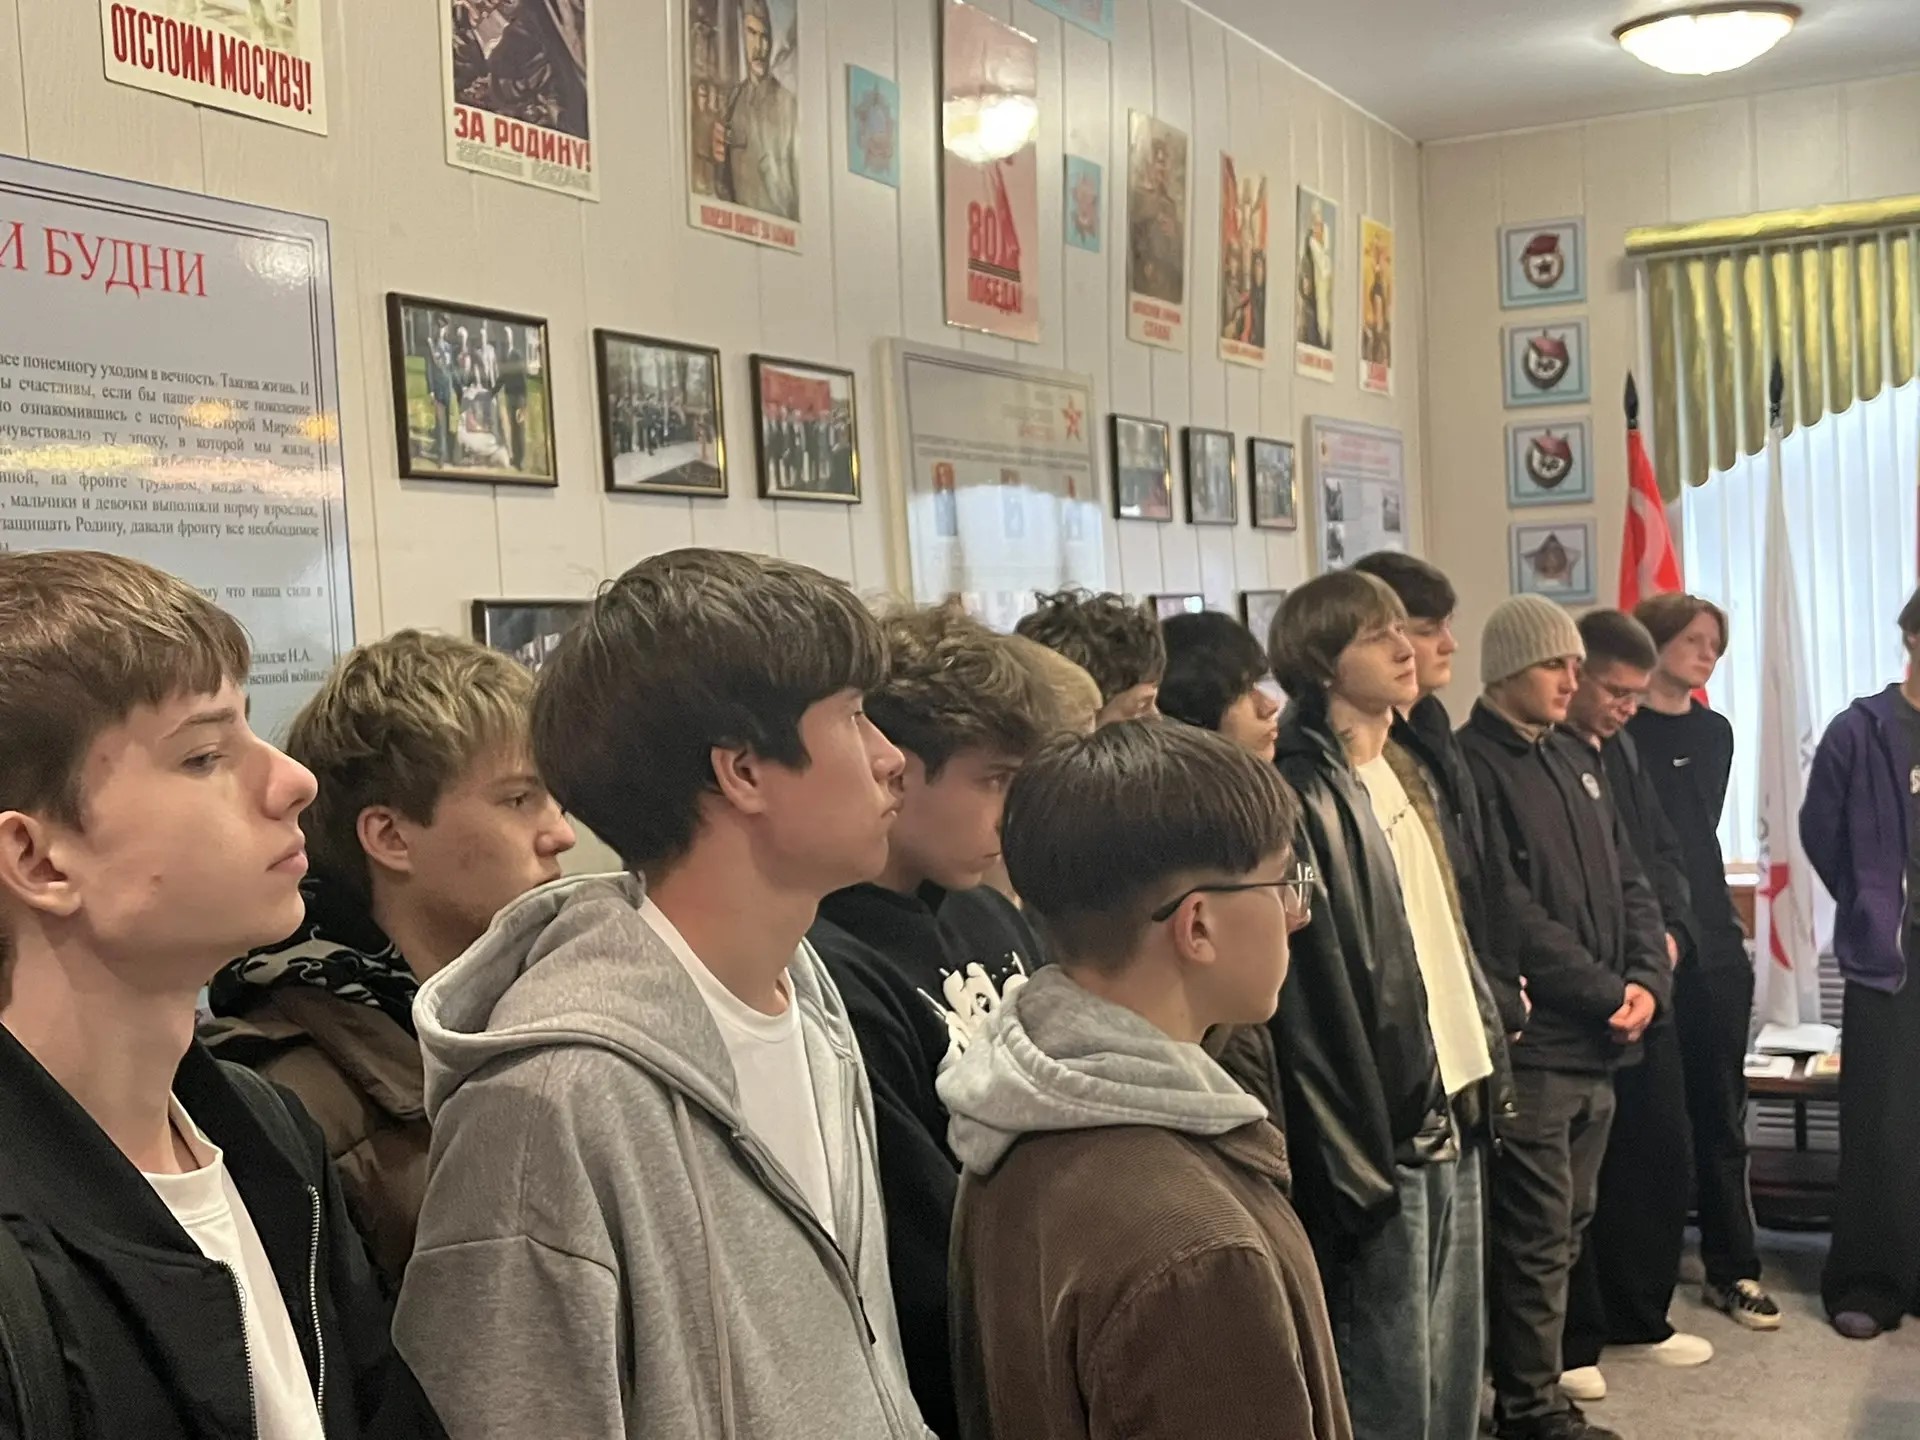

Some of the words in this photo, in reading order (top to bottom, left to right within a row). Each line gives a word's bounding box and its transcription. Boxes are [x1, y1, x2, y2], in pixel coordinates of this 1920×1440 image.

[111, 3, 215, 86] ОТСТОИМ
[219, 33, 312, 114] МОСКВУ!
[454, 107, 485, 143] ЗА
[495, 118, 592, 172] РОДИНУ!
[968, 200, 997, 266] 80
[43, 227, 208, 299] БУДНИ
[23, 355, 97, 379] понемногу
[101, 364, 148, 380] уходим
[301, 381, 310, 396] И
[19, 377, 96, 399] счастливы,
[102, 386, 132, 400] если
[138, 386, 156, 402] бы
[163, 391, 194, 405] наше
[20, 402, 127, 421] ознакомившись
[134, 411, 142, 422] с
[103, 431, 117, 446] ту
[196, 438, 244, 454] которой
[254, 443, 271, 453] мы
[51, 474, 67, 486] на
[79, 471, 128, 492] фронте
[10, 495, 77, 509] мальчики
[82, 498, 90, 509] и
[95, 498, 148, 513] девочки
[152, 499, 219, 514] выполняли
[223, 503, 259, 519] норму
[76, 516, 126, 536] Родину,
[130, 522, 173, 534] давали
[177, 519, 221, 538] фронту
[226, 523, 245, 536] все
[226, 586, 246, 598] что
